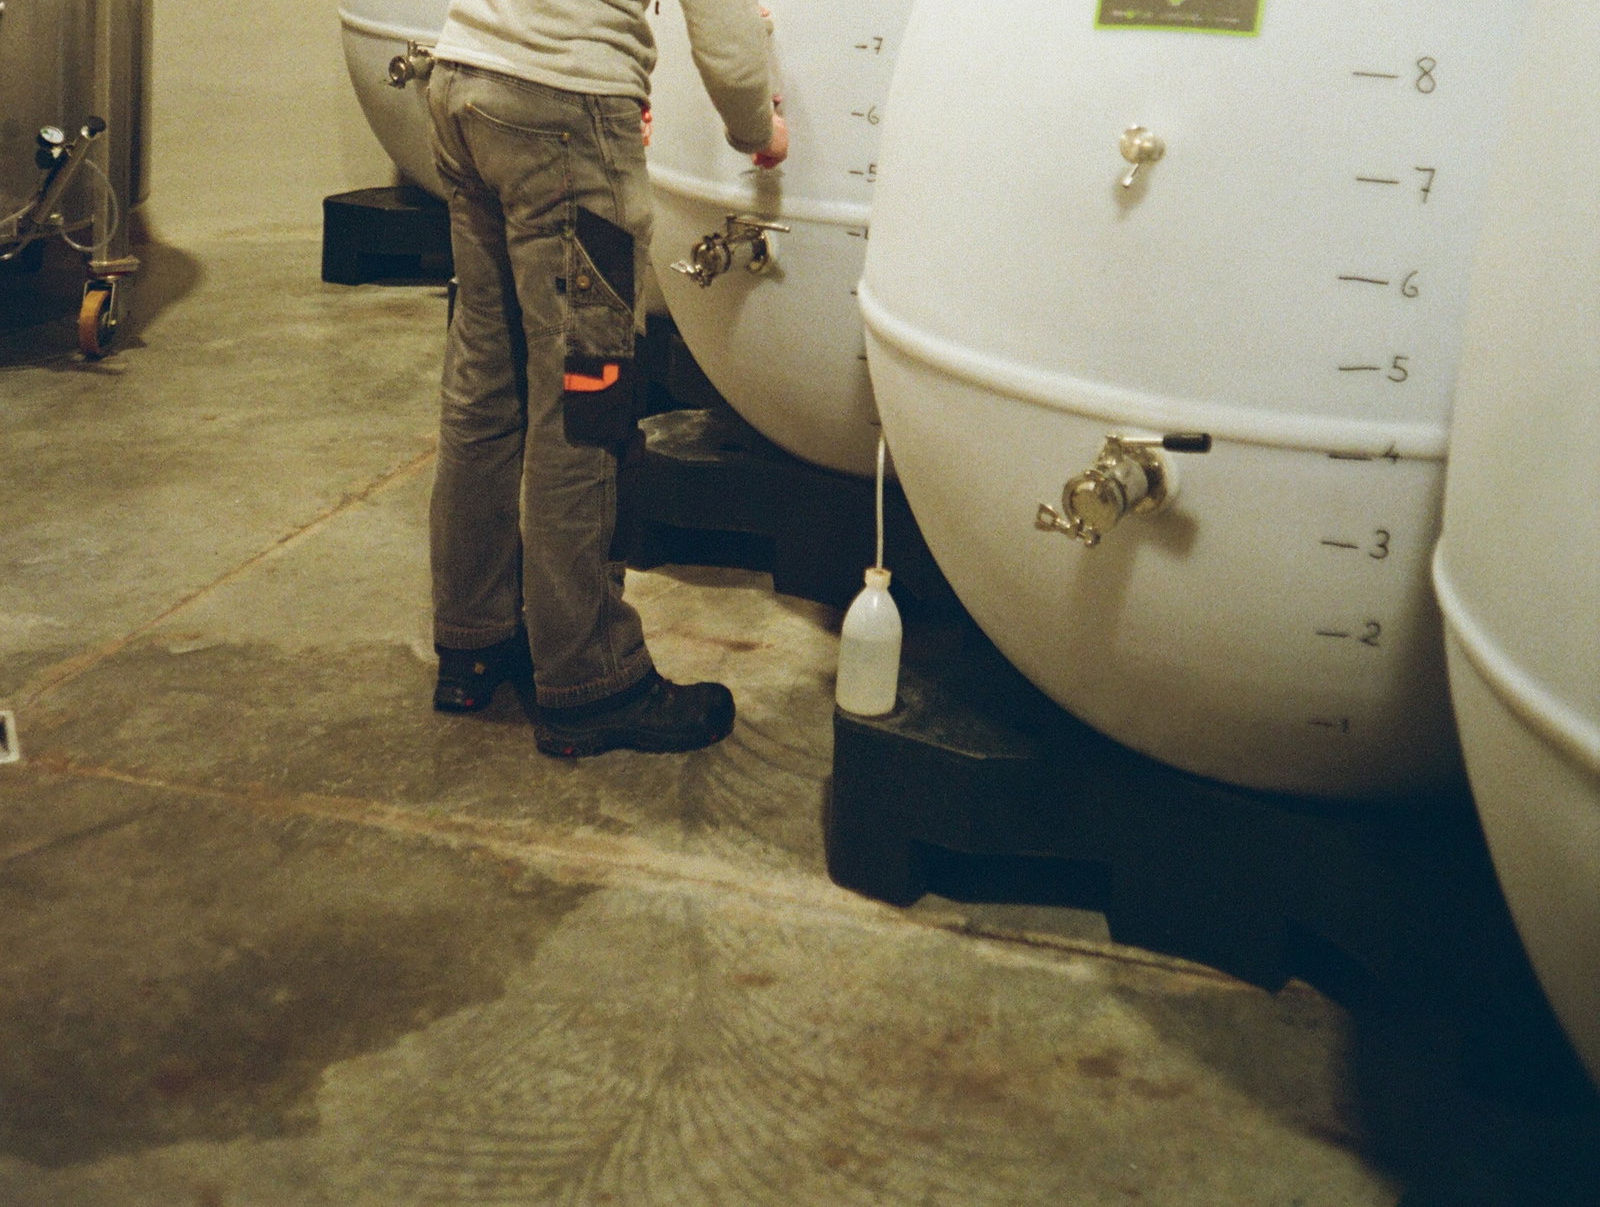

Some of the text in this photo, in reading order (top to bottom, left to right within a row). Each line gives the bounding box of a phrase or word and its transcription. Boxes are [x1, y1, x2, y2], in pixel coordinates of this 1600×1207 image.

[872, 36, 884, 55] 7
[1415, 56, 1437, 94] 8
[867, 105, 880, 126] 6
[1414, 166, 1437, 204] 7
[1401, 269, 1419, 298] 6
[1387, 355, 1410, 383] 5
[1368, 528, 1391, 560] 3
[1359, 621, 1382, 647] 2
